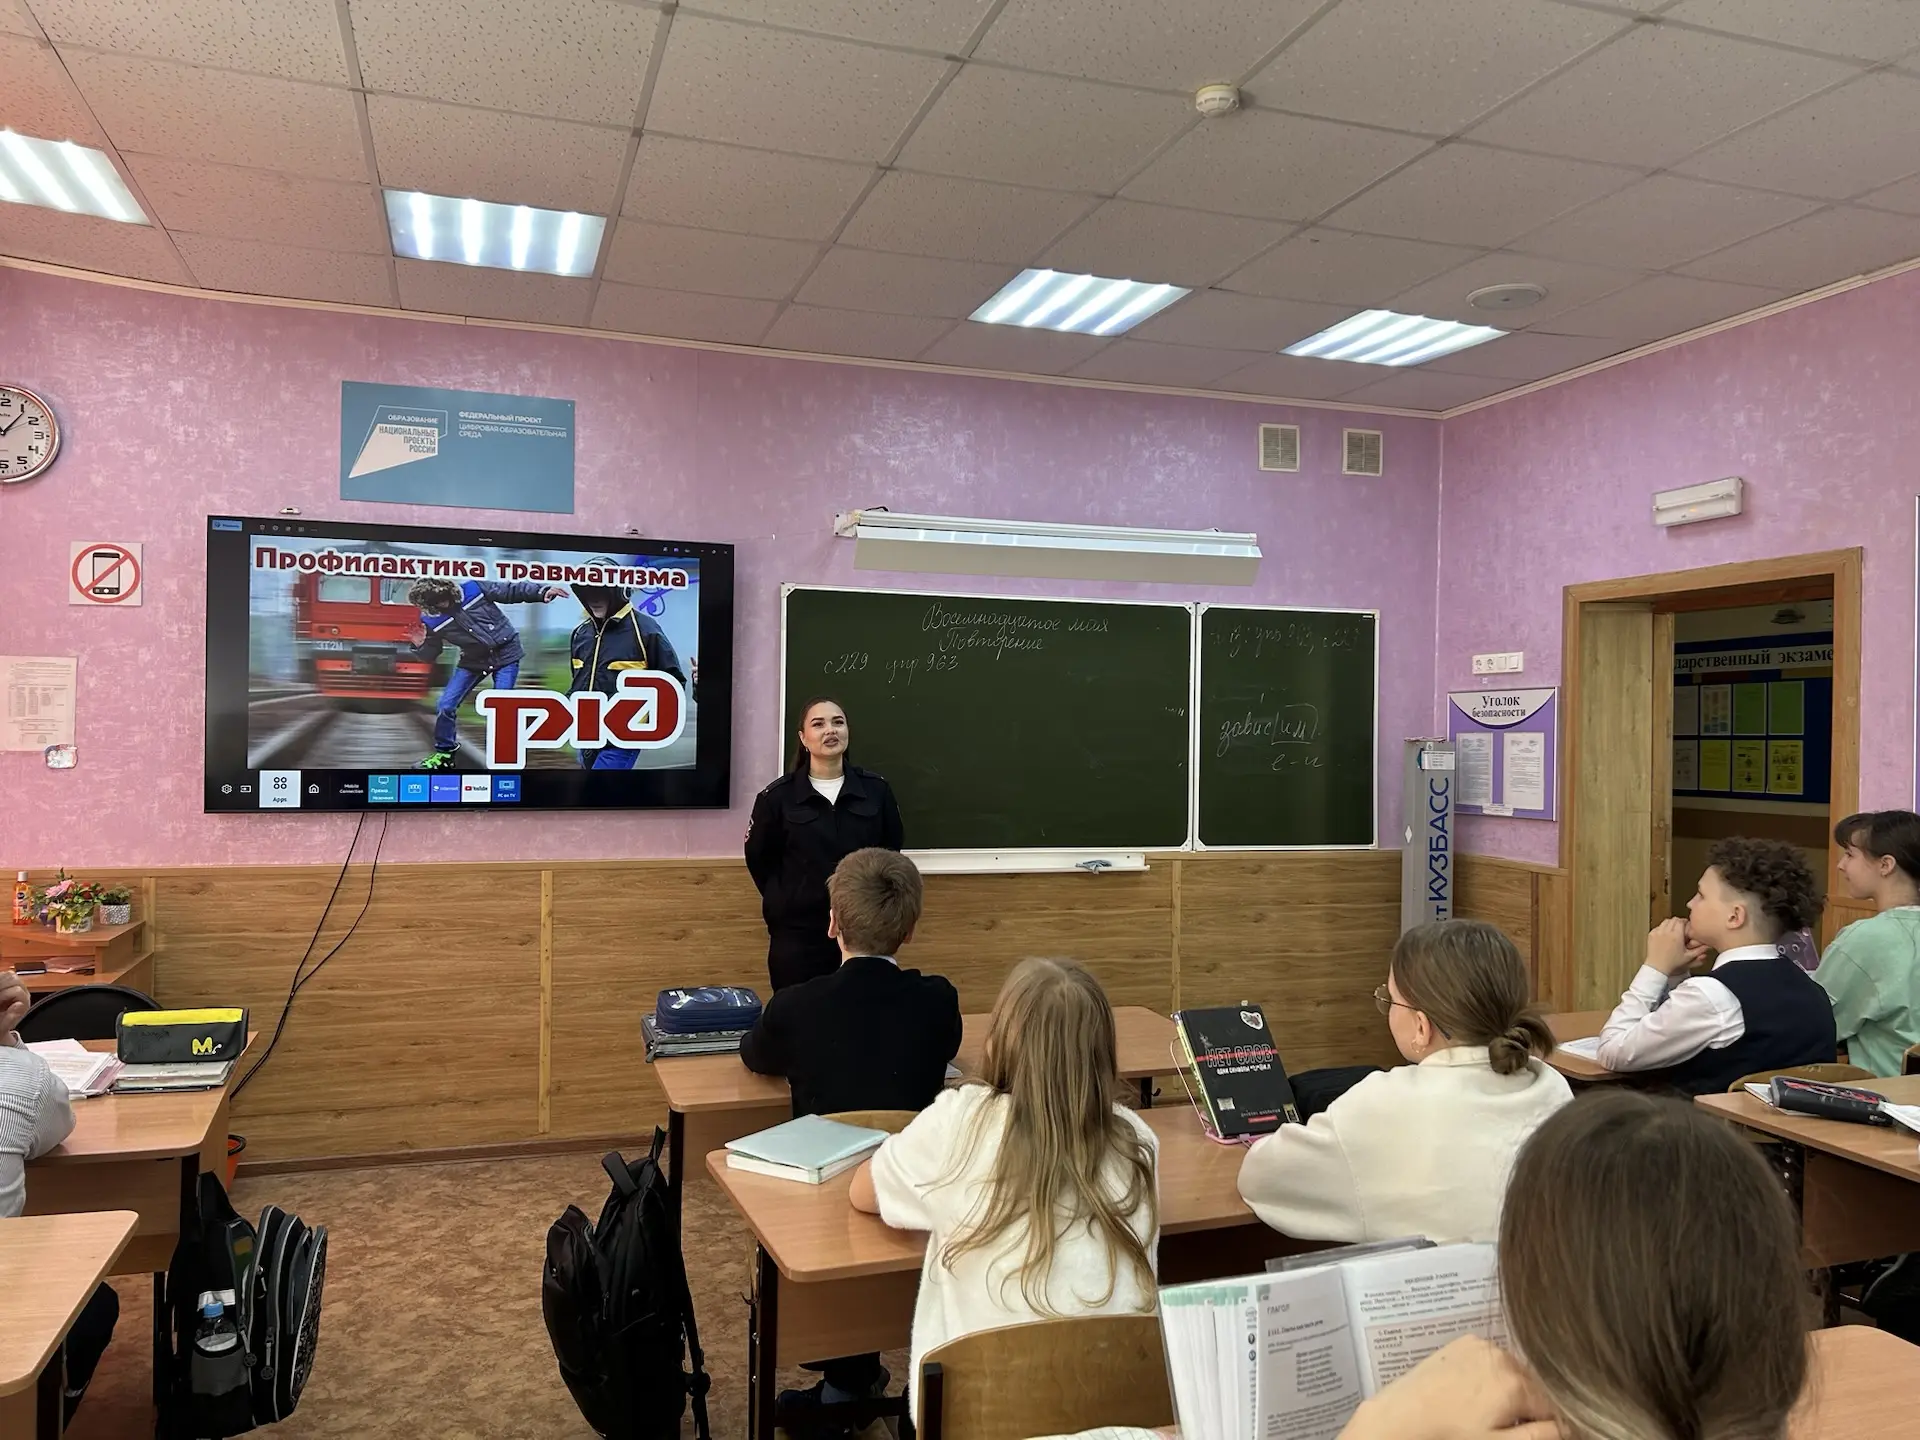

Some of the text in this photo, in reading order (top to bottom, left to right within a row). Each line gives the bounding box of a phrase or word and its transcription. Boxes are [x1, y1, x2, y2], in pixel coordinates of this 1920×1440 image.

[27, 416, 39, 426] 2
[387, 414, 439, 425] ОБРАЗОВАНИЕ
[458, 411, 543, 424] ФЕДЕРАЛЬНЫЙ ПРОЕКТ
[34, 431, 44, 440] 3
[379, 425, 437, 438] НАЦИОНАЛЬНЫЕ
[458, 423, 567, 439] ЦИФРОВАЯ ОБРАЗОВАТЕЛЬНАЯ
[458, 431, 483, 439] СРЕДА
[403, 436, 437, 446] ПРОЕКТЫ
[28, 445, 39, 454] 4
[409, 444, 436, 454] РОССИИ
[17, 456, 28, 464] 5
[256, 547, 687, 589] Профилактика травматизма
[1068, 617, 1109, 633] мая
[939, 625, 1043, 660] Повторение
[1778, 647, 1833, 663] экзаме
[1482, 695, 1521, 708] Уголок
[1471, 708, 1526, 718] безопасности
[1428, 777, 1450, 901] КУЗБАСС
[1206, 1047, 1232, 1068] НЕТ
[1267, 1303, 1290, 1315] ГЛАГОЛ
